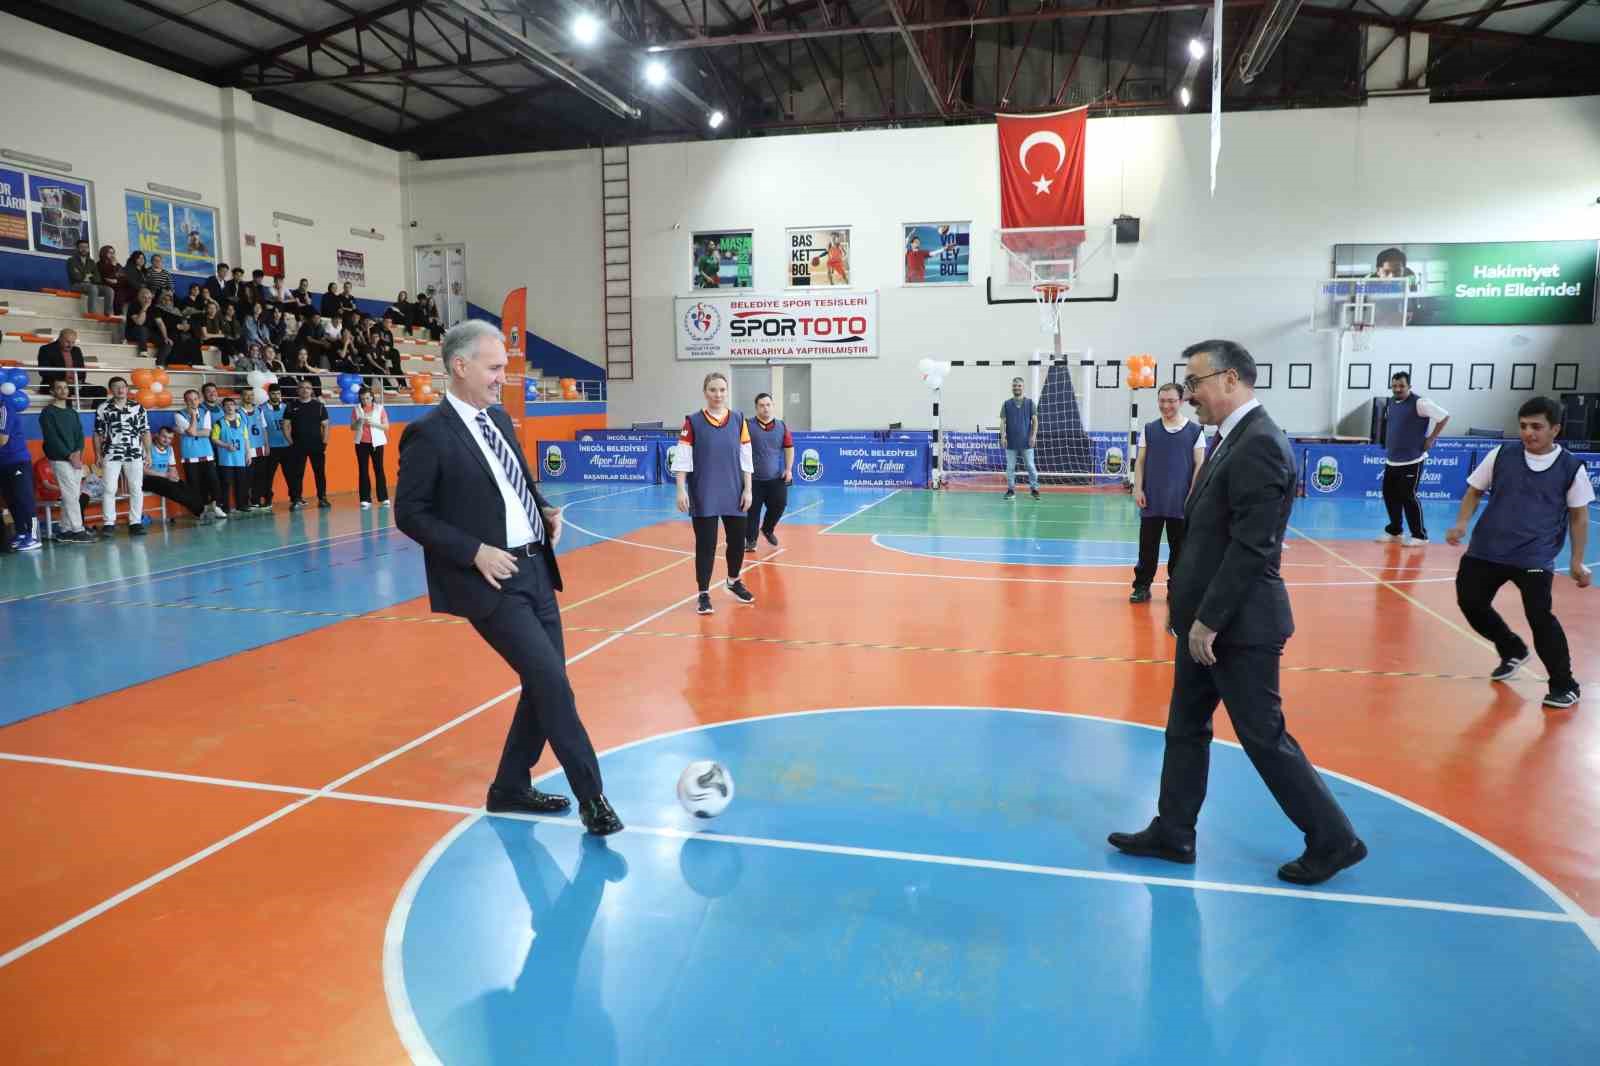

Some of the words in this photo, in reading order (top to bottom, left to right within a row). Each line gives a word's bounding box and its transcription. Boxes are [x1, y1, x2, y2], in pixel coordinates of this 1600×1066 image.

[792, 235, 812, 247] BAS
[792, 249, 810, 261] KET
[792, 263, 811, 276] BOL
[940, 263, 959, 276] BOL
[1473, 264, 1560, 281] Hakimiyet
[1455, 283, 1501, 298] Senin
[1504, 282, 1581, 296] Ellerinde!
[730, 300, 780, 309] BELEDİYE
[782, 300, 811, 308] SPOR
[731, 347, 794, 356] KATKILARIYLA
[579, 444, 605, 452] İNEGÖL
[606, 444, 648, 452] BELEDİYESİ
[839, 448, 869, 457] İNEGÖL
[871, 448, 917, 457] BELEDİYESİ
